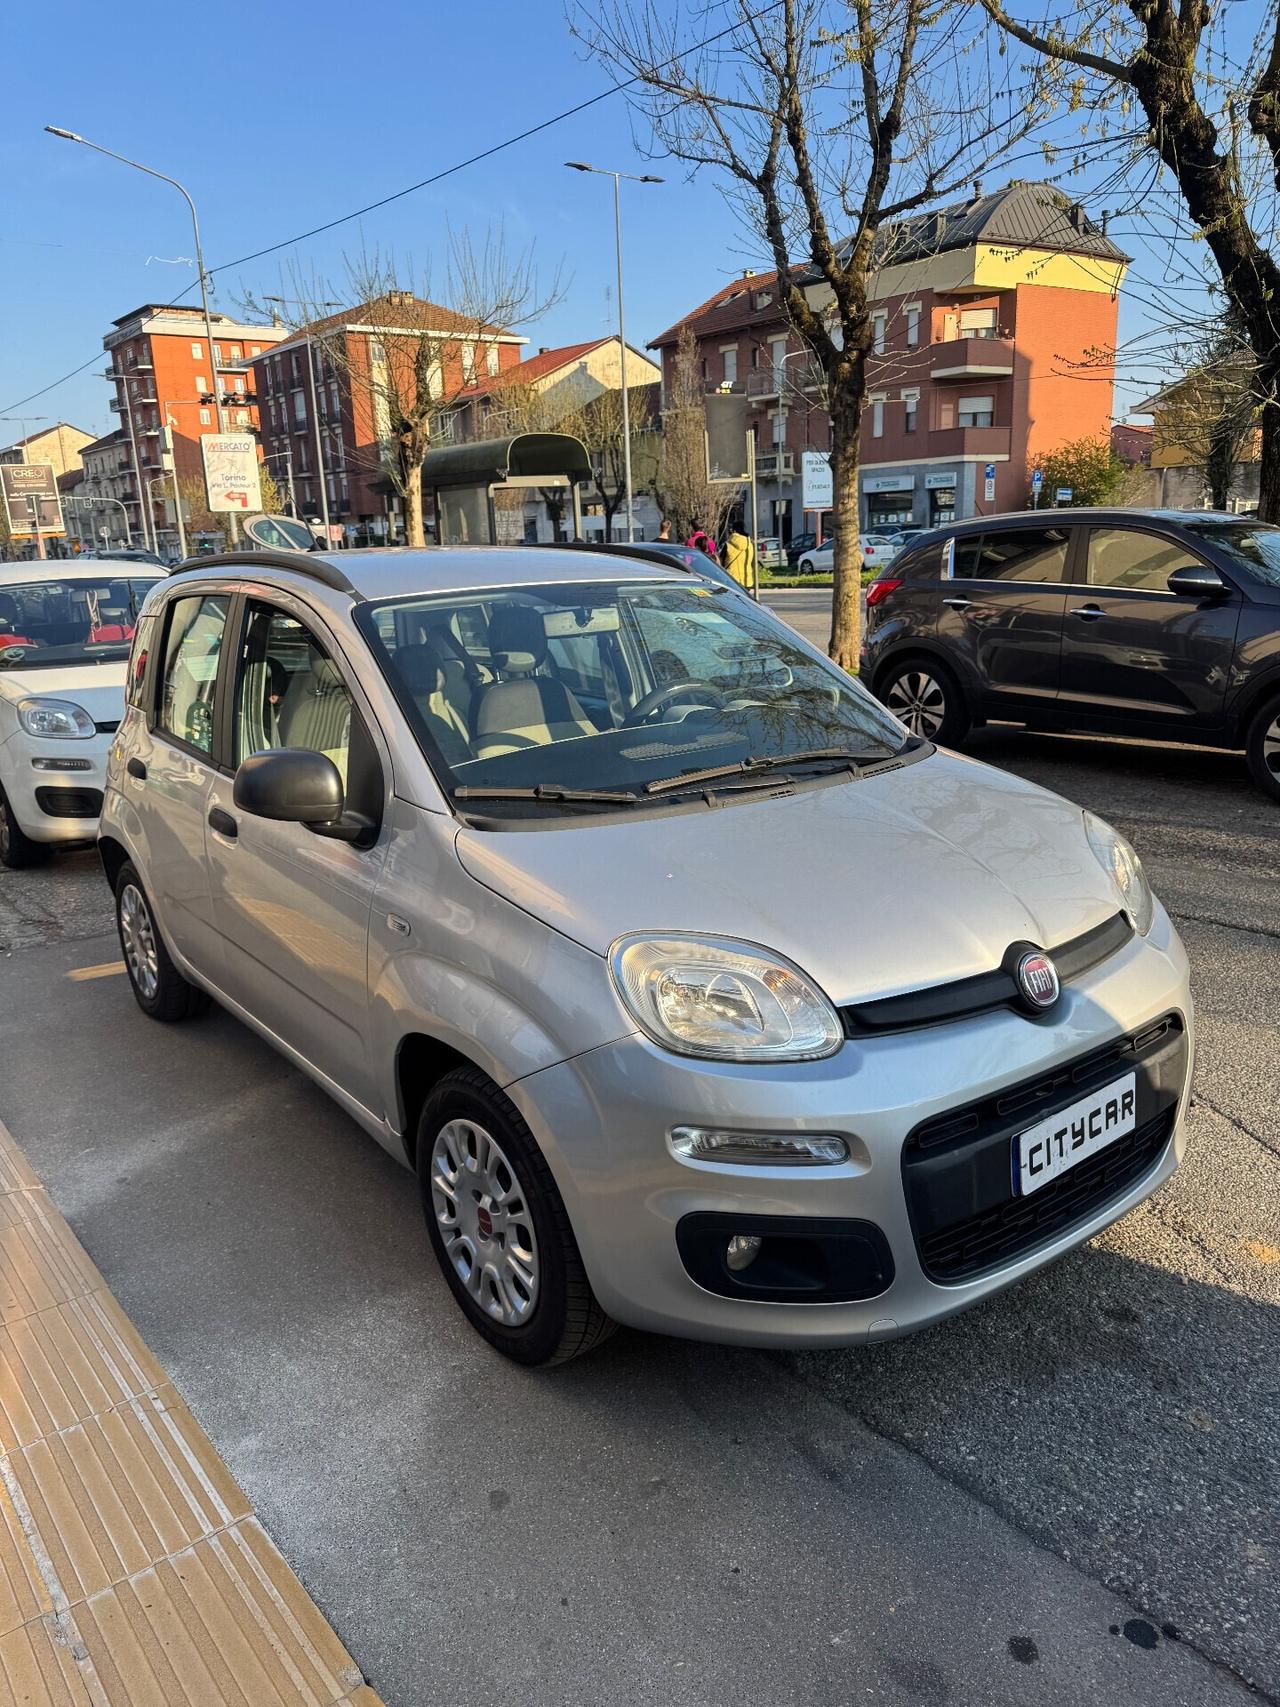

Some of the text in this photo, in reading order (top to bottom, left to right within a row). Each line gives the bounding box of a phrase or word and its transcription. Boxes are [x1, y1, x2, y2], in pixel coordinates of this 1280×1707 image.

[208, 442, 250, 451] MERCATO
[1034, 472, 1040, 480] P
[1029, 966, 1051, 994] FIAT
[1029, 1089, 1134, 1177] CITYCAR
